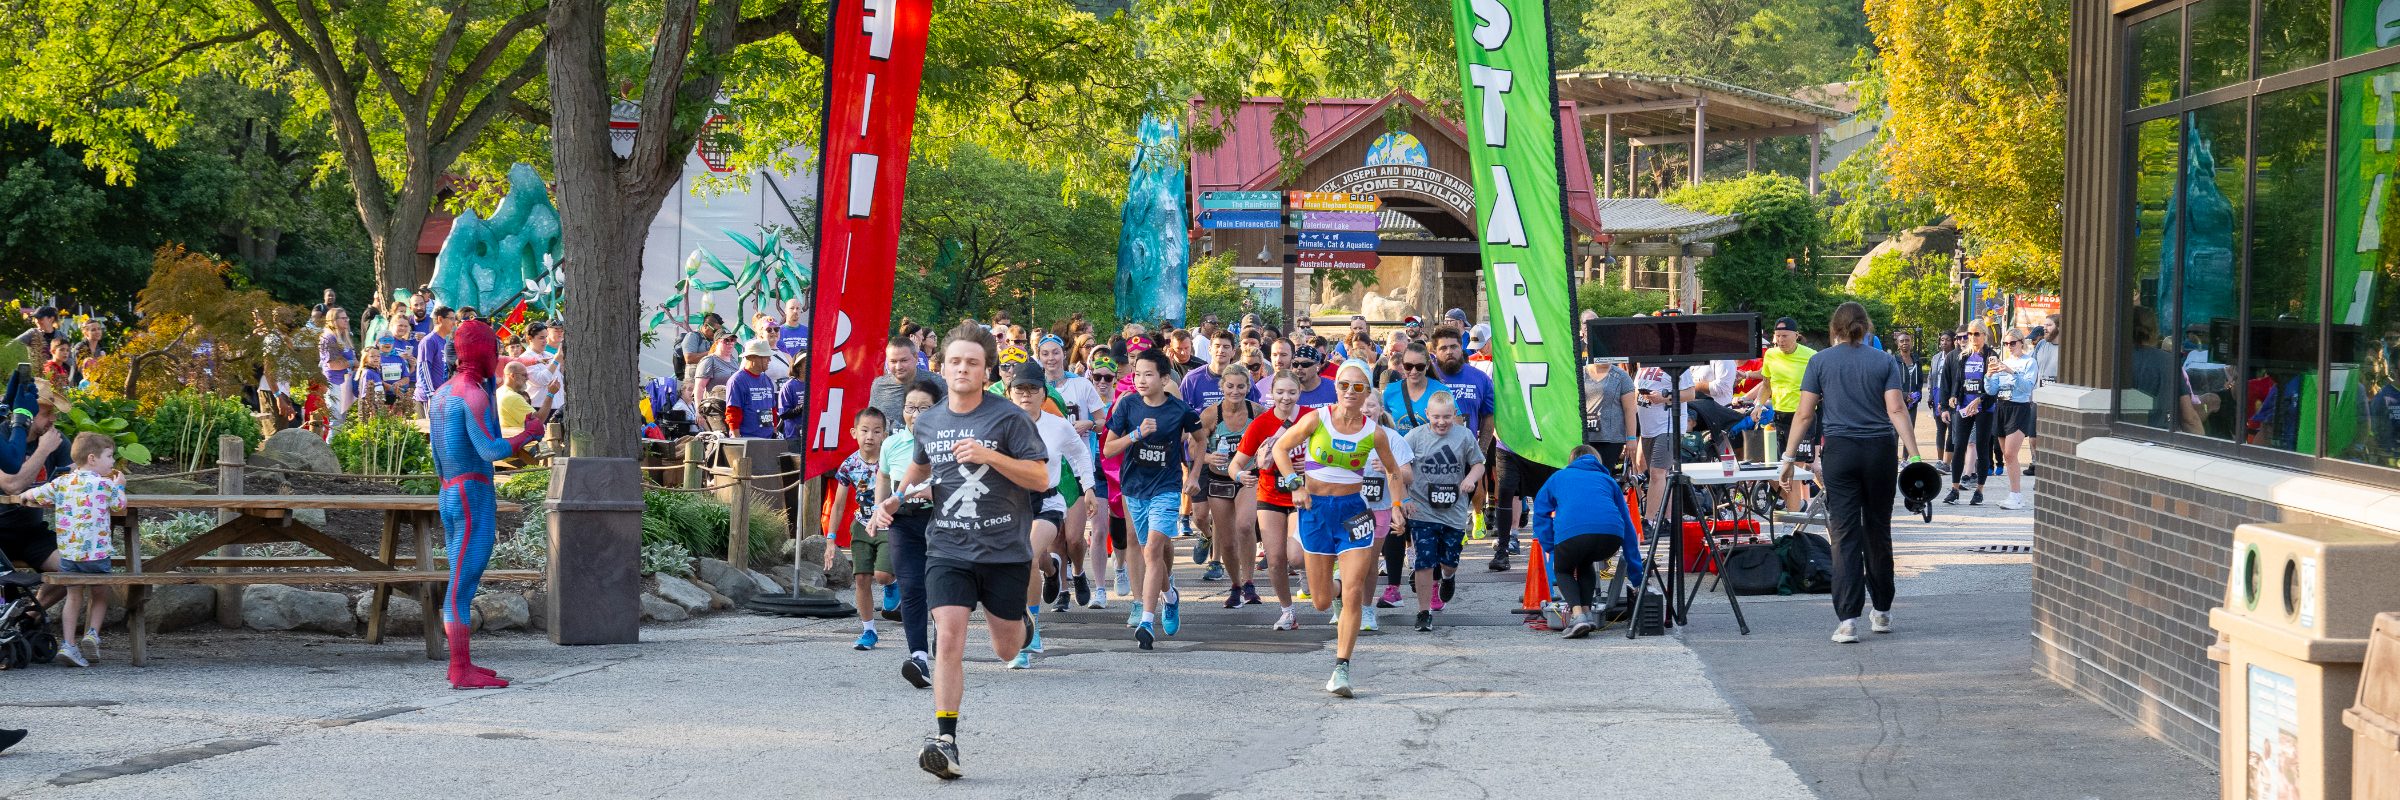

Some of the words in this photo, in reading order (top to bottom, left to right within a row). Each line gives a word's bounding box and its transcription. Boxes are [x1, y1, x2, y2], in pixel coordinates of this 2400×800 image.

[1318, 180, 1341, 193] ACK,
[1342, 168, 1377, 185] JOSEPH
[1380, 166, 1400, 176] AND
[1403, 167, 1443, 182] MORTON
[1351, 178, 1399, 194] COME
[1403, 179, 1472, 214] PAVILION
[1322, 201, 1347, 209] Elephant
[1348, 202, 1374, 211] Crossing
[1216, 220, 1233, 228] Main
[1234, 220, 1279, 230] Entrance/Exit
[1303, 221, 1333, 230] Waterfowl
[1334, 222, 1350, 230] Lake
[1469, 0, 1548, 441] START
[1298, 240, 1326, 248] Primate,
[1346, 242, 1374, 250] Aquatics
[1300, 260, 1333, 268] Australian
[1333, 261, 1366, 269] Adventure
[2039, 295, 2061, 303] FROS
[936, 429, 956, 439] NOT
[958, 428, 975, 438] ALL
[925, 440, 999, 454] UPEROES
[1797, 443, 1812, 453] 914
[929, 454, 954, 464] WEAR
[1139, 448, 1166, 462] 5931
[1420, 463, 1461, 475] adidas
[1361, 484, 1381, 497] 929
[1431, 491, 1457, 503] 5926
[973, 521, 981, 530] A
[983, 514, 1012, 528] CROSS
[1352, 518, 1375, 541] 9224
